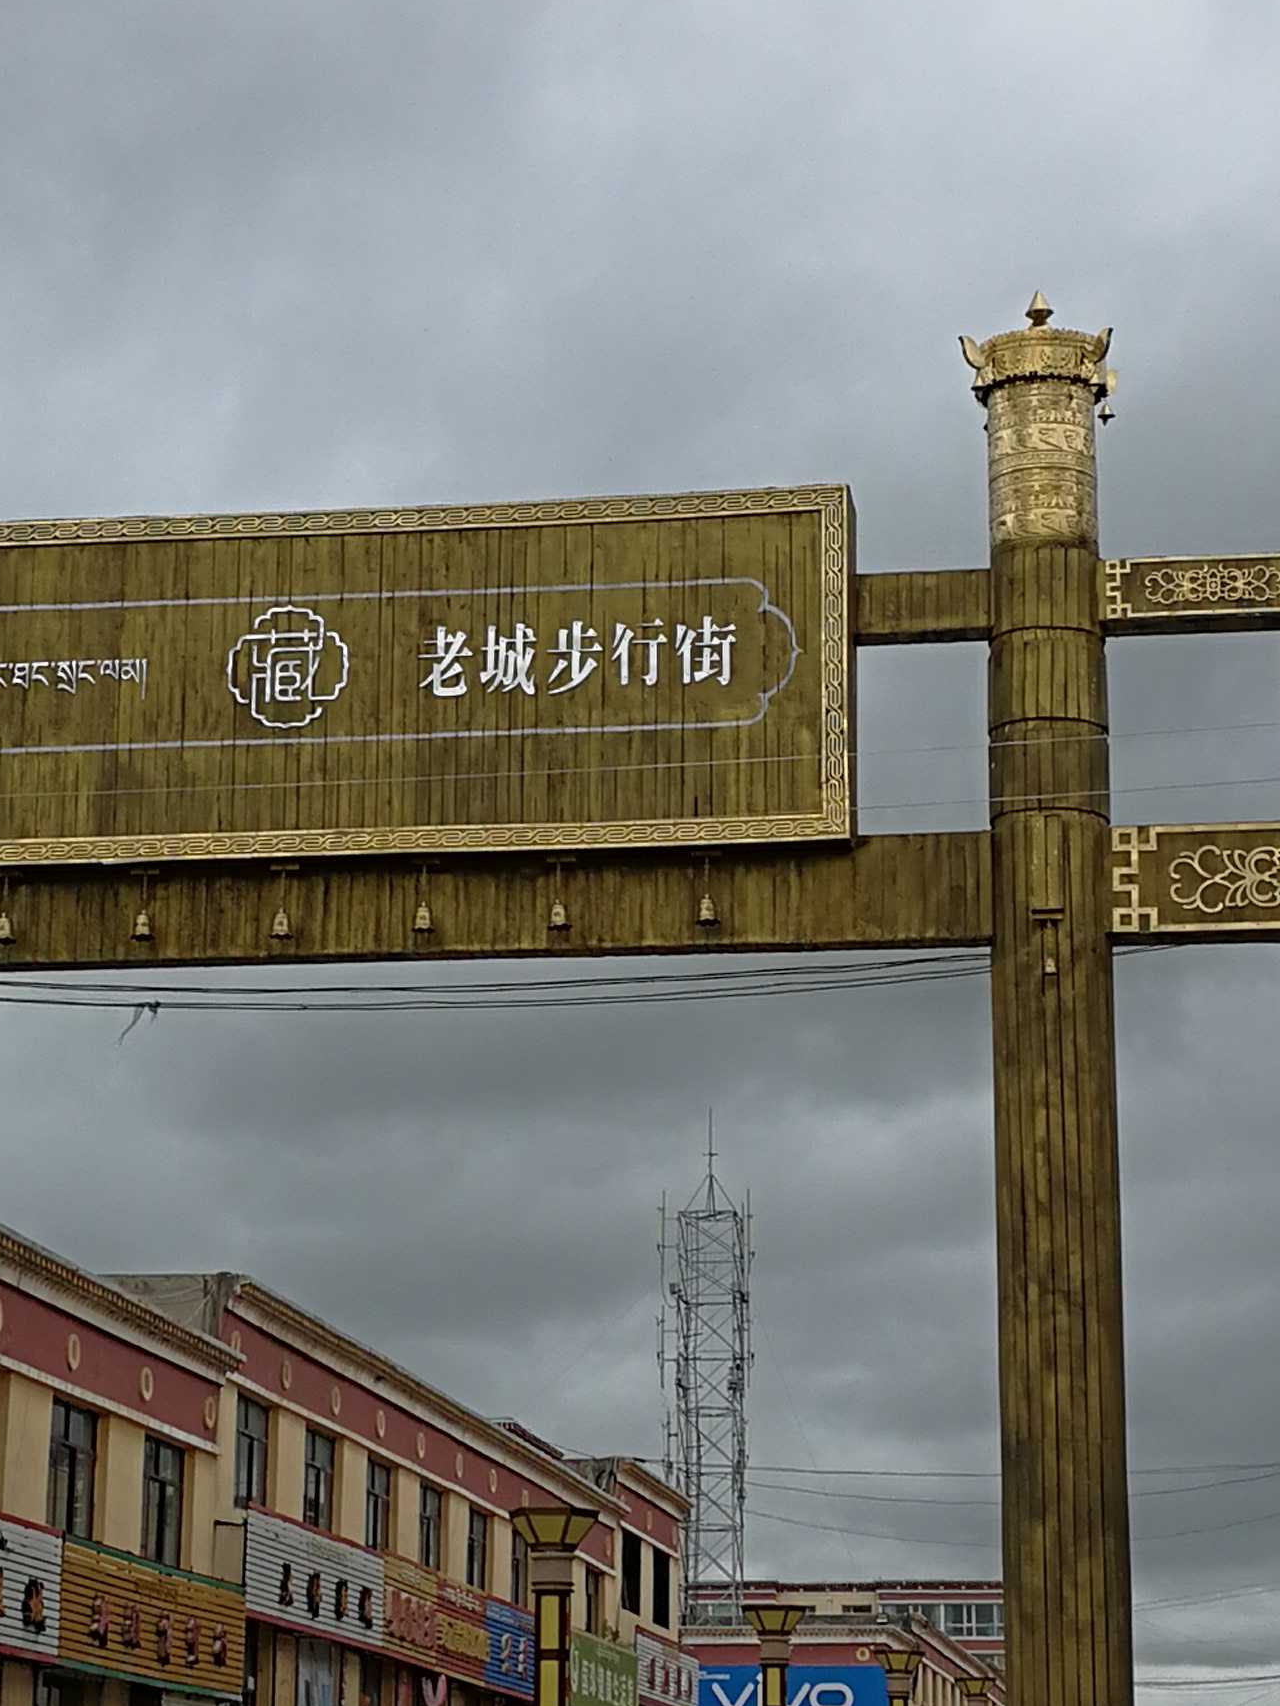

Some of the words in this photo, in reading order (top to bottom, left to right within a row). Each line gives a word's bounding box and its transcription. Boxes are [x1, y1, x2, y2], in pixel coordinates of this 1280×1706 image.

[418, 615, 737, 697] 老城步行街
